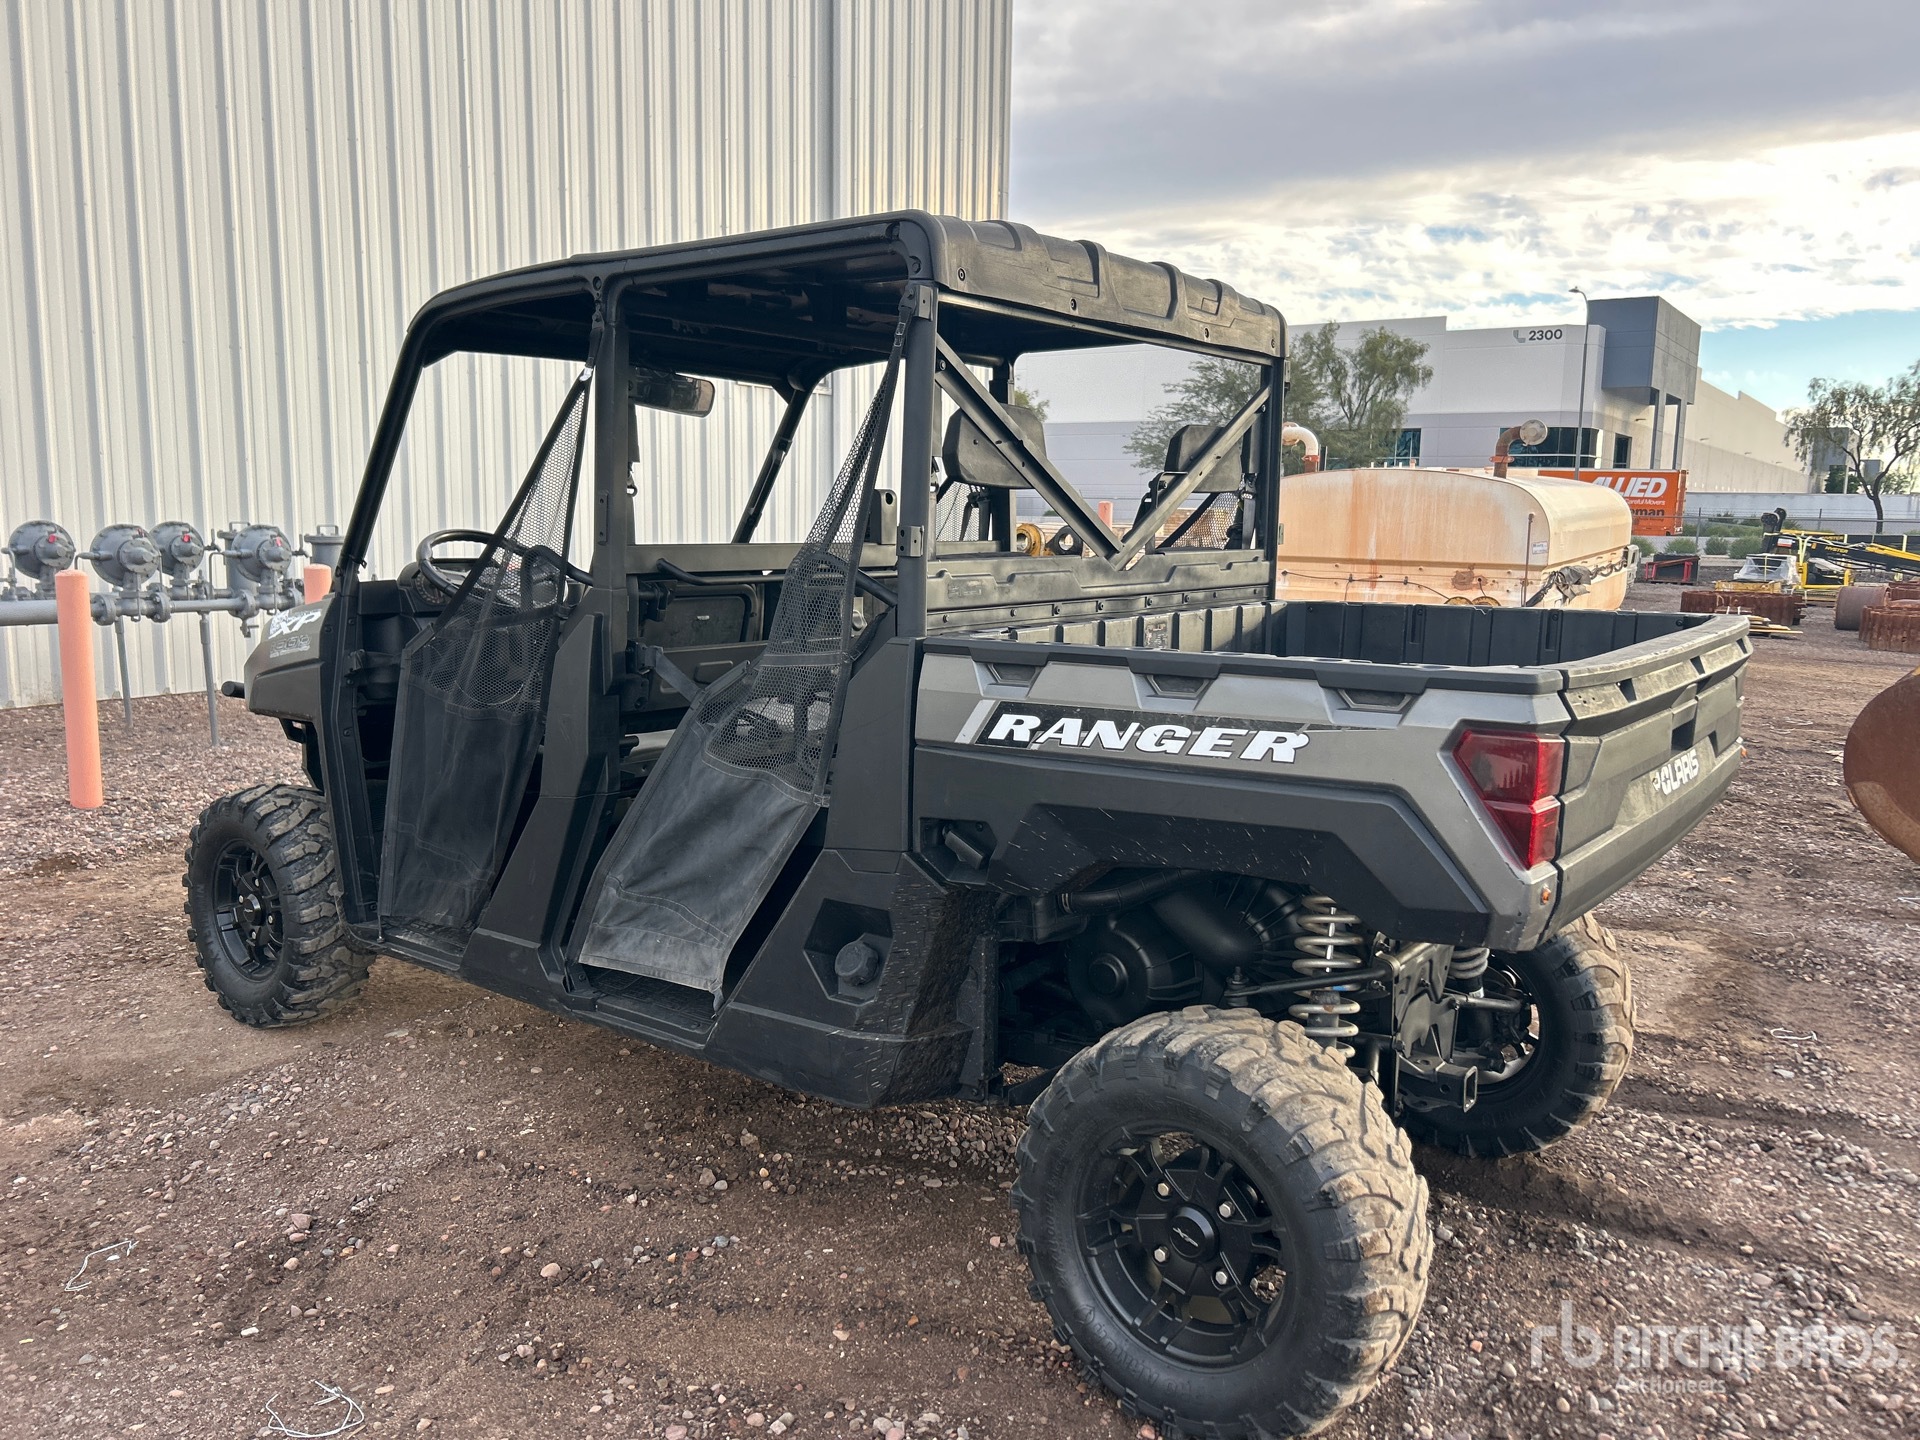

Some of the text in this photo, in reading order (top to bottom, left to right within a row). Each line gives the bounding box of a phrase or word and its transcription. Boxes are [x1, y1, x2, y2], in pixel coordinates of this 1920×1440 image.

[1528, 328, 1563, 341] 2300
[1645, 498, 1666, 506] Movers
[268, 609, 322, 640] XP
[987, 712, 1310, 764] RANGER
